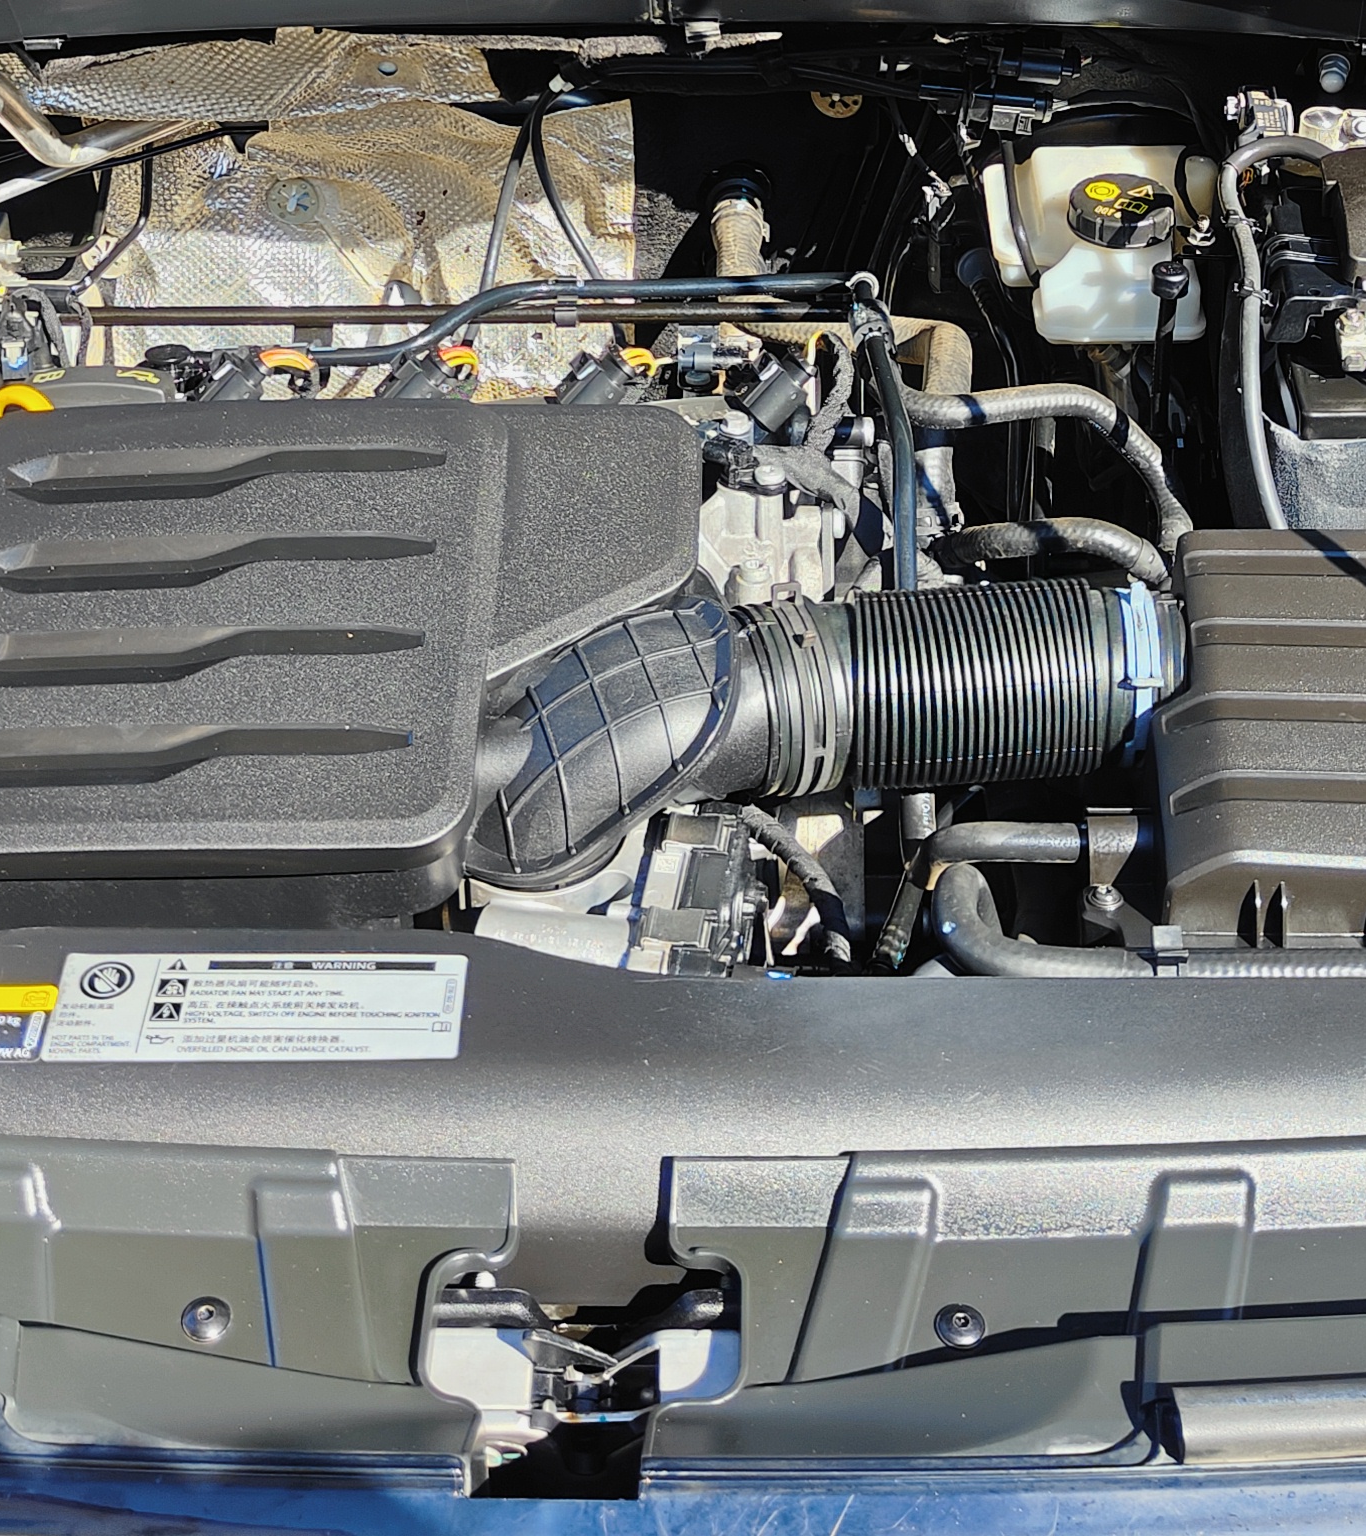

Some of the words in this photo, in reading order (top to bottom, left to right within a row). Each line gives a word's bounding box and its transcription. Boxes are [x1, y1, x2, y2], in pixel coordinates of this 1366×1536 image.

[1094, 205, 1116, 216] DOT
[311, 961, 376, 970] WARNING
[176, 1046, 224, 1054] OVERFILLED
[225, 1046, 254, 1054] ENGINE
[256, 1046, 270, 1054] OIL
[272, 1046, 290, 1054] CAN
[292, 1046, 327, 1054] DAMAGE
